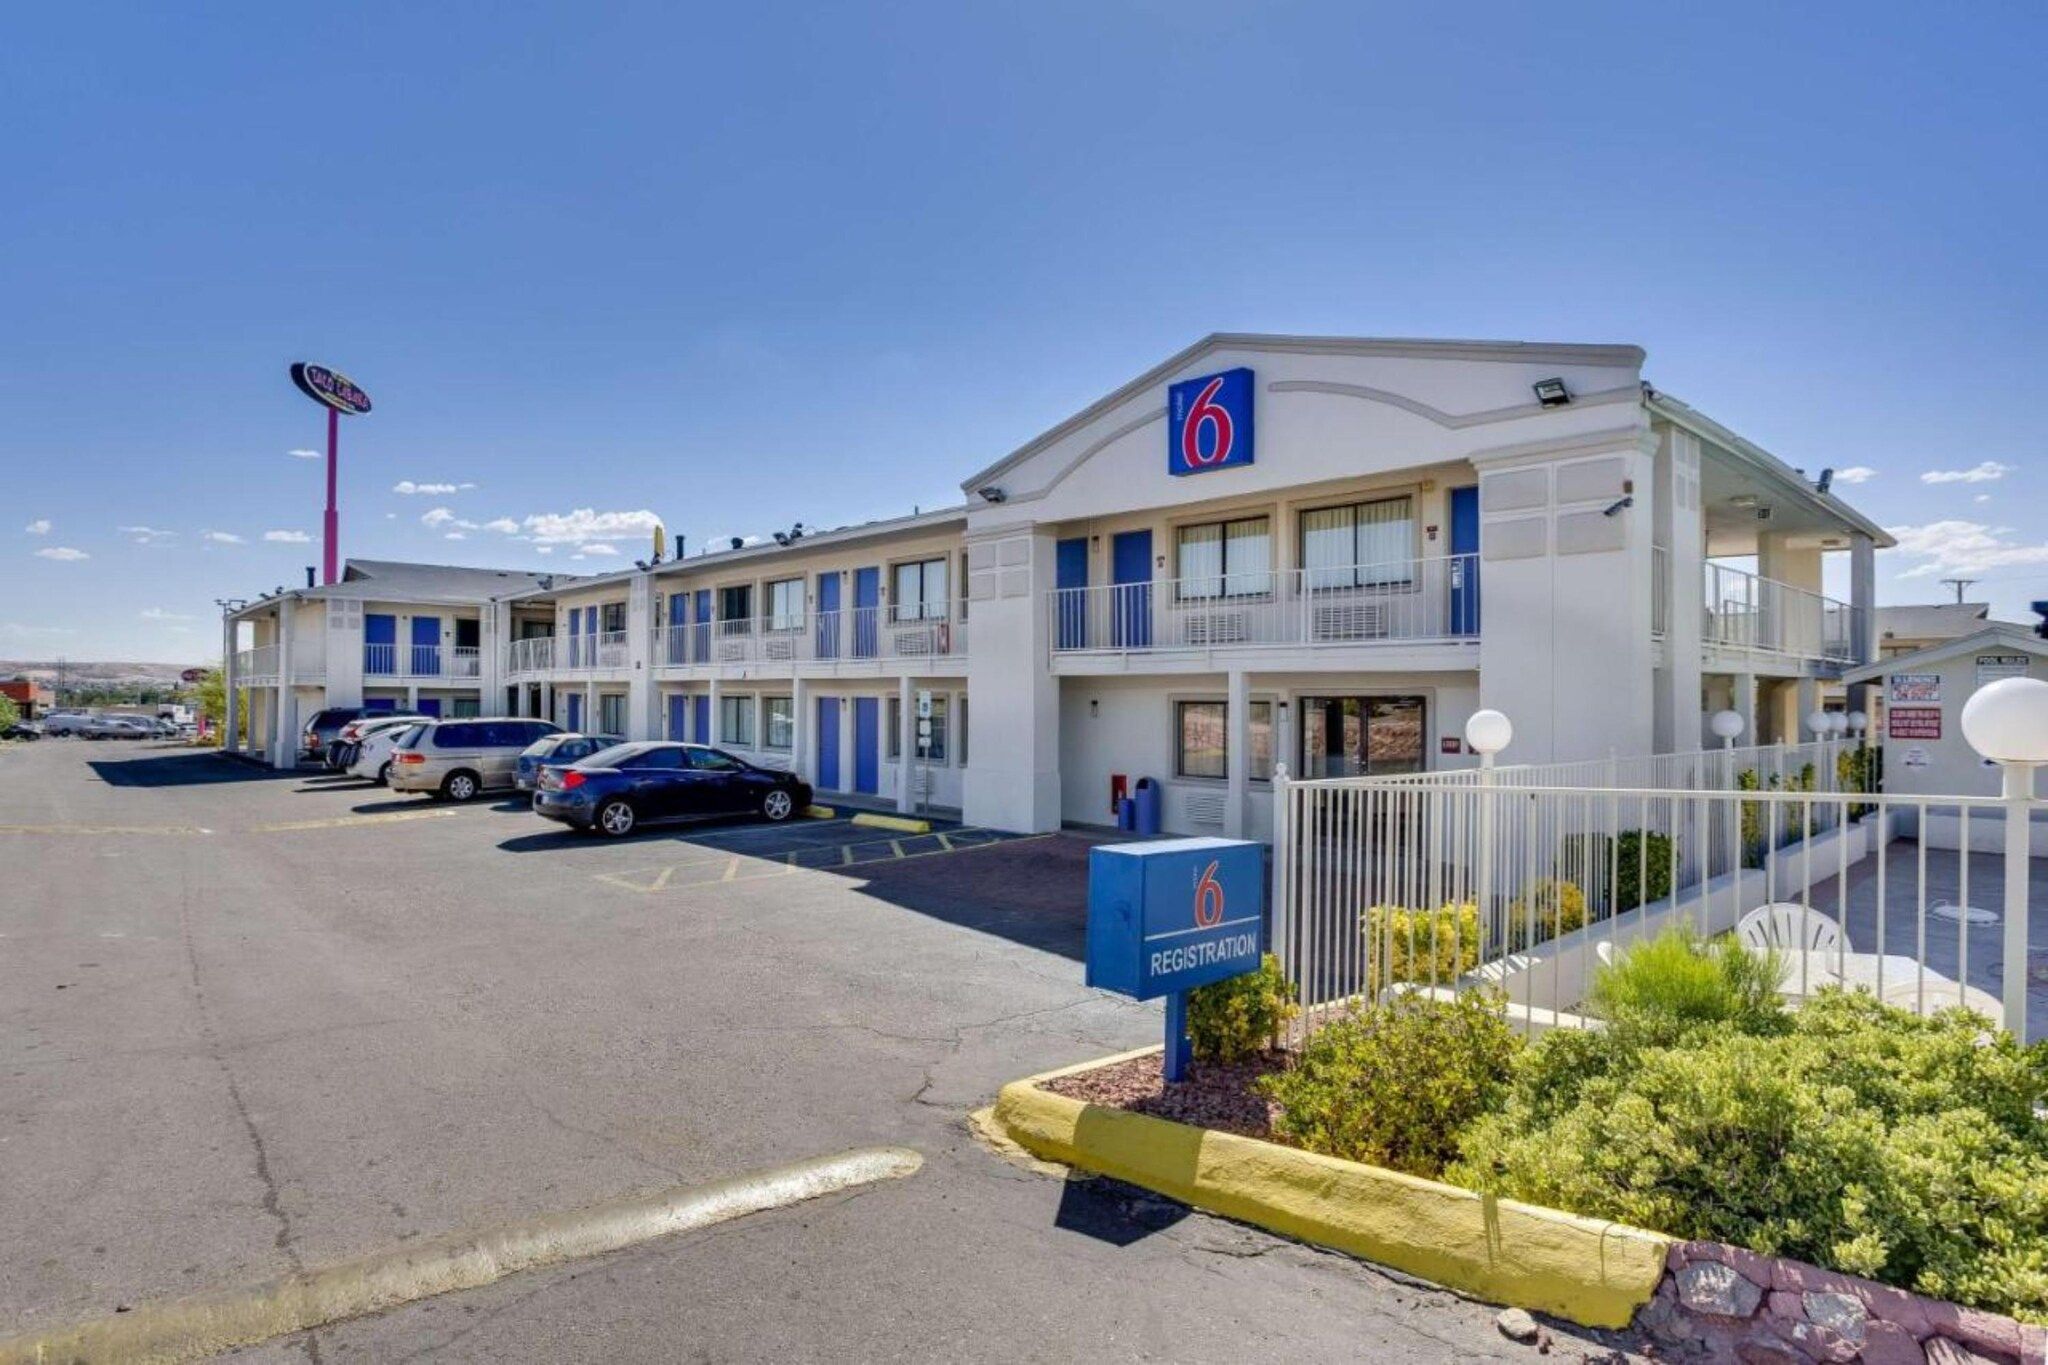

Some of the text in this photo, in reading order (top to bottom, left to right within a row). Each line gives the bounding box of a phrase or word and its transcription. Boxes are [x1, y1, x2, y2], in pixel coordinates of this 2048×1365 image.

[1182, 377, 1232, 467] 6
[1195, 860, 1223, 929] 6
[1151, 933, 1256, 976] REGISTRATION
